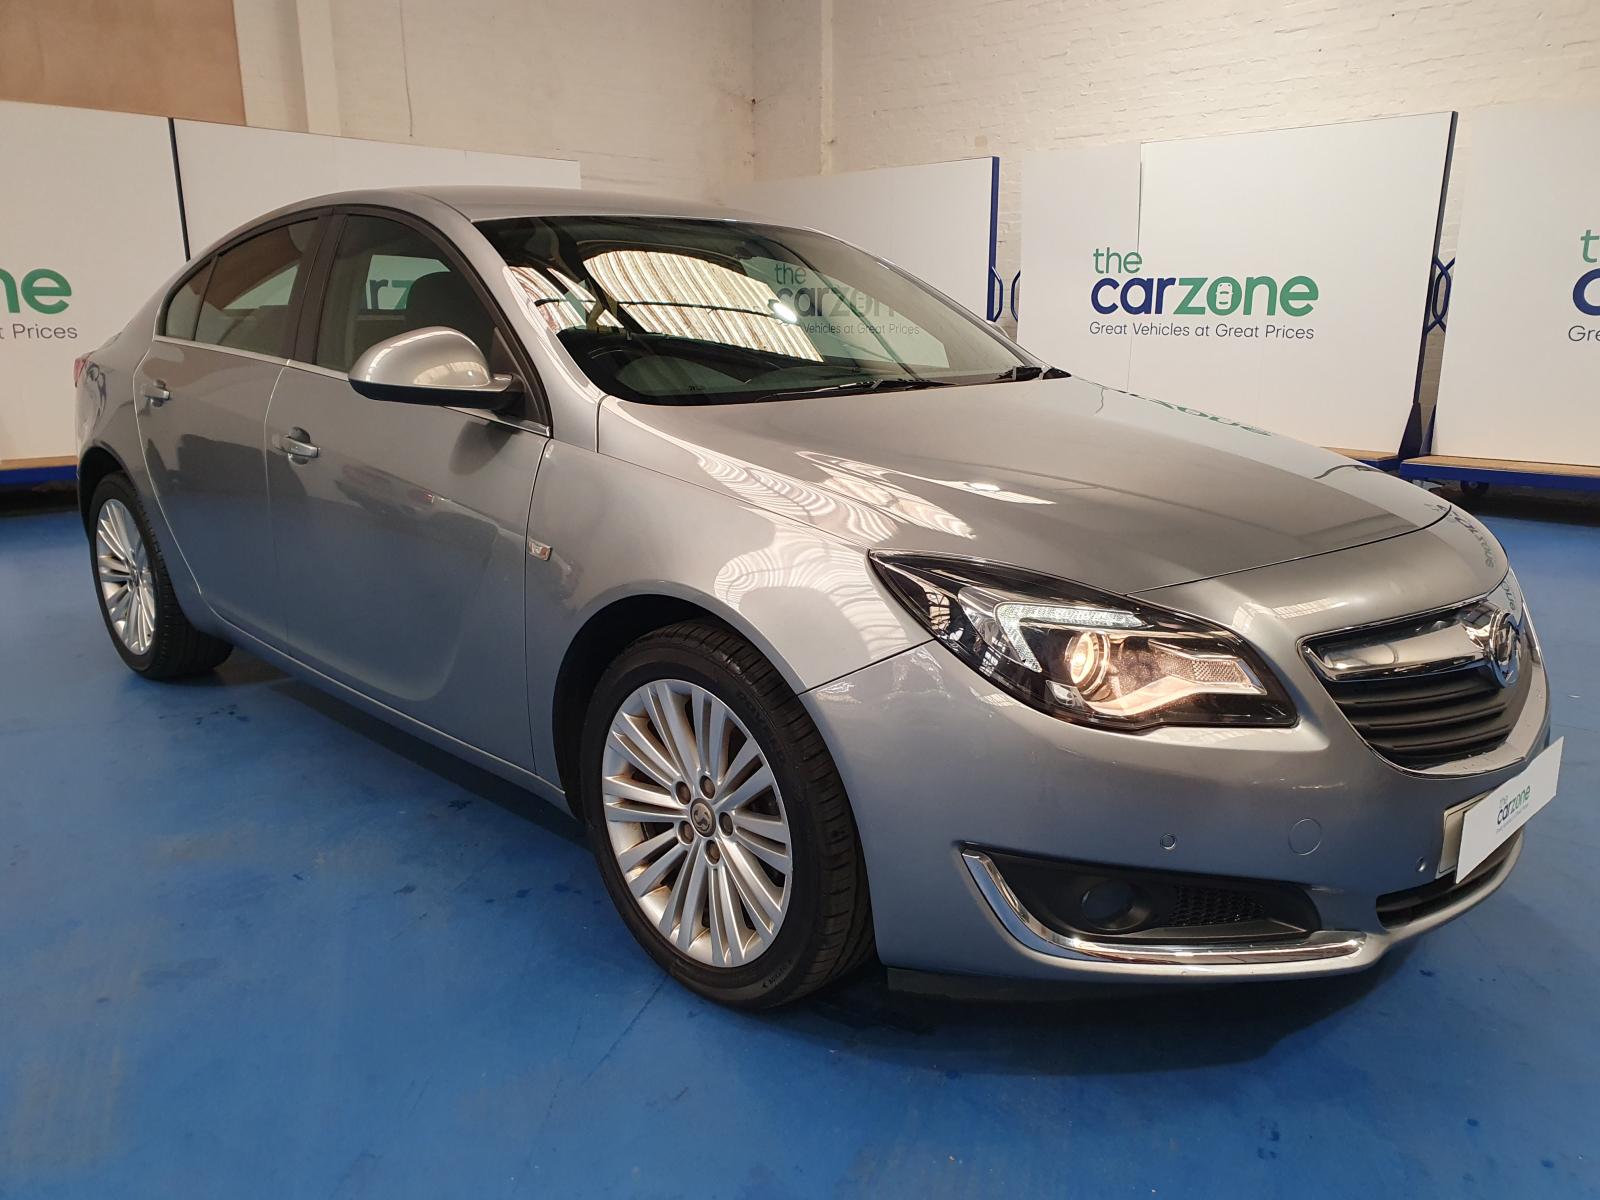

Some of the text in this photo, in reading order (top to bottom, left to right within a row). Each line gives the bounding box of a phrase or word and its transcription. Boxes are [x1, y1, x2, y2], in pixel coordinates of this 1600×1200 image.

[1093, 247, 1143, 274] the
[774, 263, 807, 285] the
[1090, 275, 1319, 317] carzone
[12, 322, 78, 340] Prices
[804, 322, 841, 335] Vehicles
[843, 323, 854, 334] at
[889, 323, 920, 336] Prices
[1089, 321, 1315, 340] Great Vehicles at Great Prices
[1497, 784, 1531, 825] carzone
